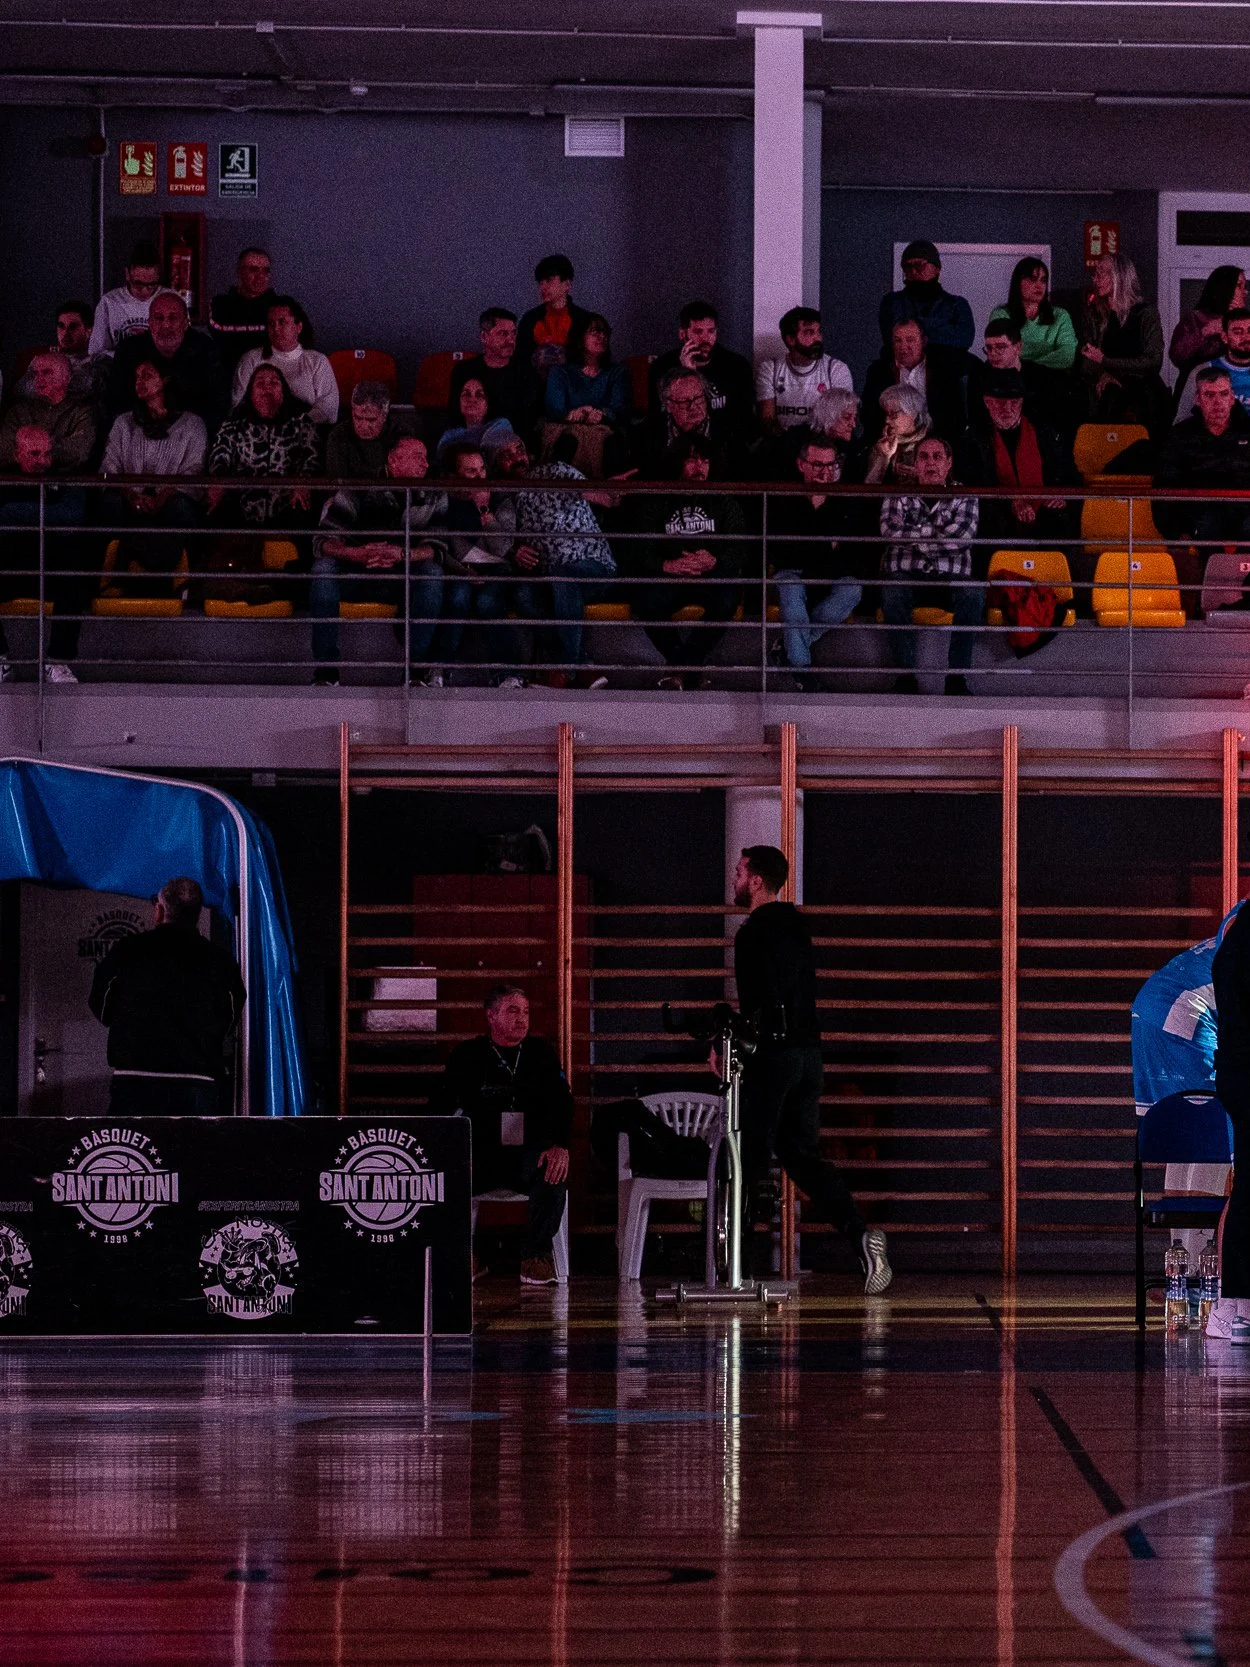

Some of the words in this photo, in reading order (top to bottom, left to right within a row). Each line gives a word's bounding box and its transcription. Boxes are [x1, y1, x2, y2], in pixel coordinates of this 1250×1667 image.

[169, 183, 206, 192] EXTINTOR
[80, 1127, 151, 1151] BÀSQUET
[347, 1127, 417, 1151] BÀSQUET
[52, 1171, 103, 1203] SANT
[104, 1171, 180, 1203] ANTONI
[319, 1171, 370, 1202] SANT
[371, 1171, 445, 1203] ANTONI
[104, 1234, 129, 1244] 1998
[370, 1233, 395, 1243] 1998
